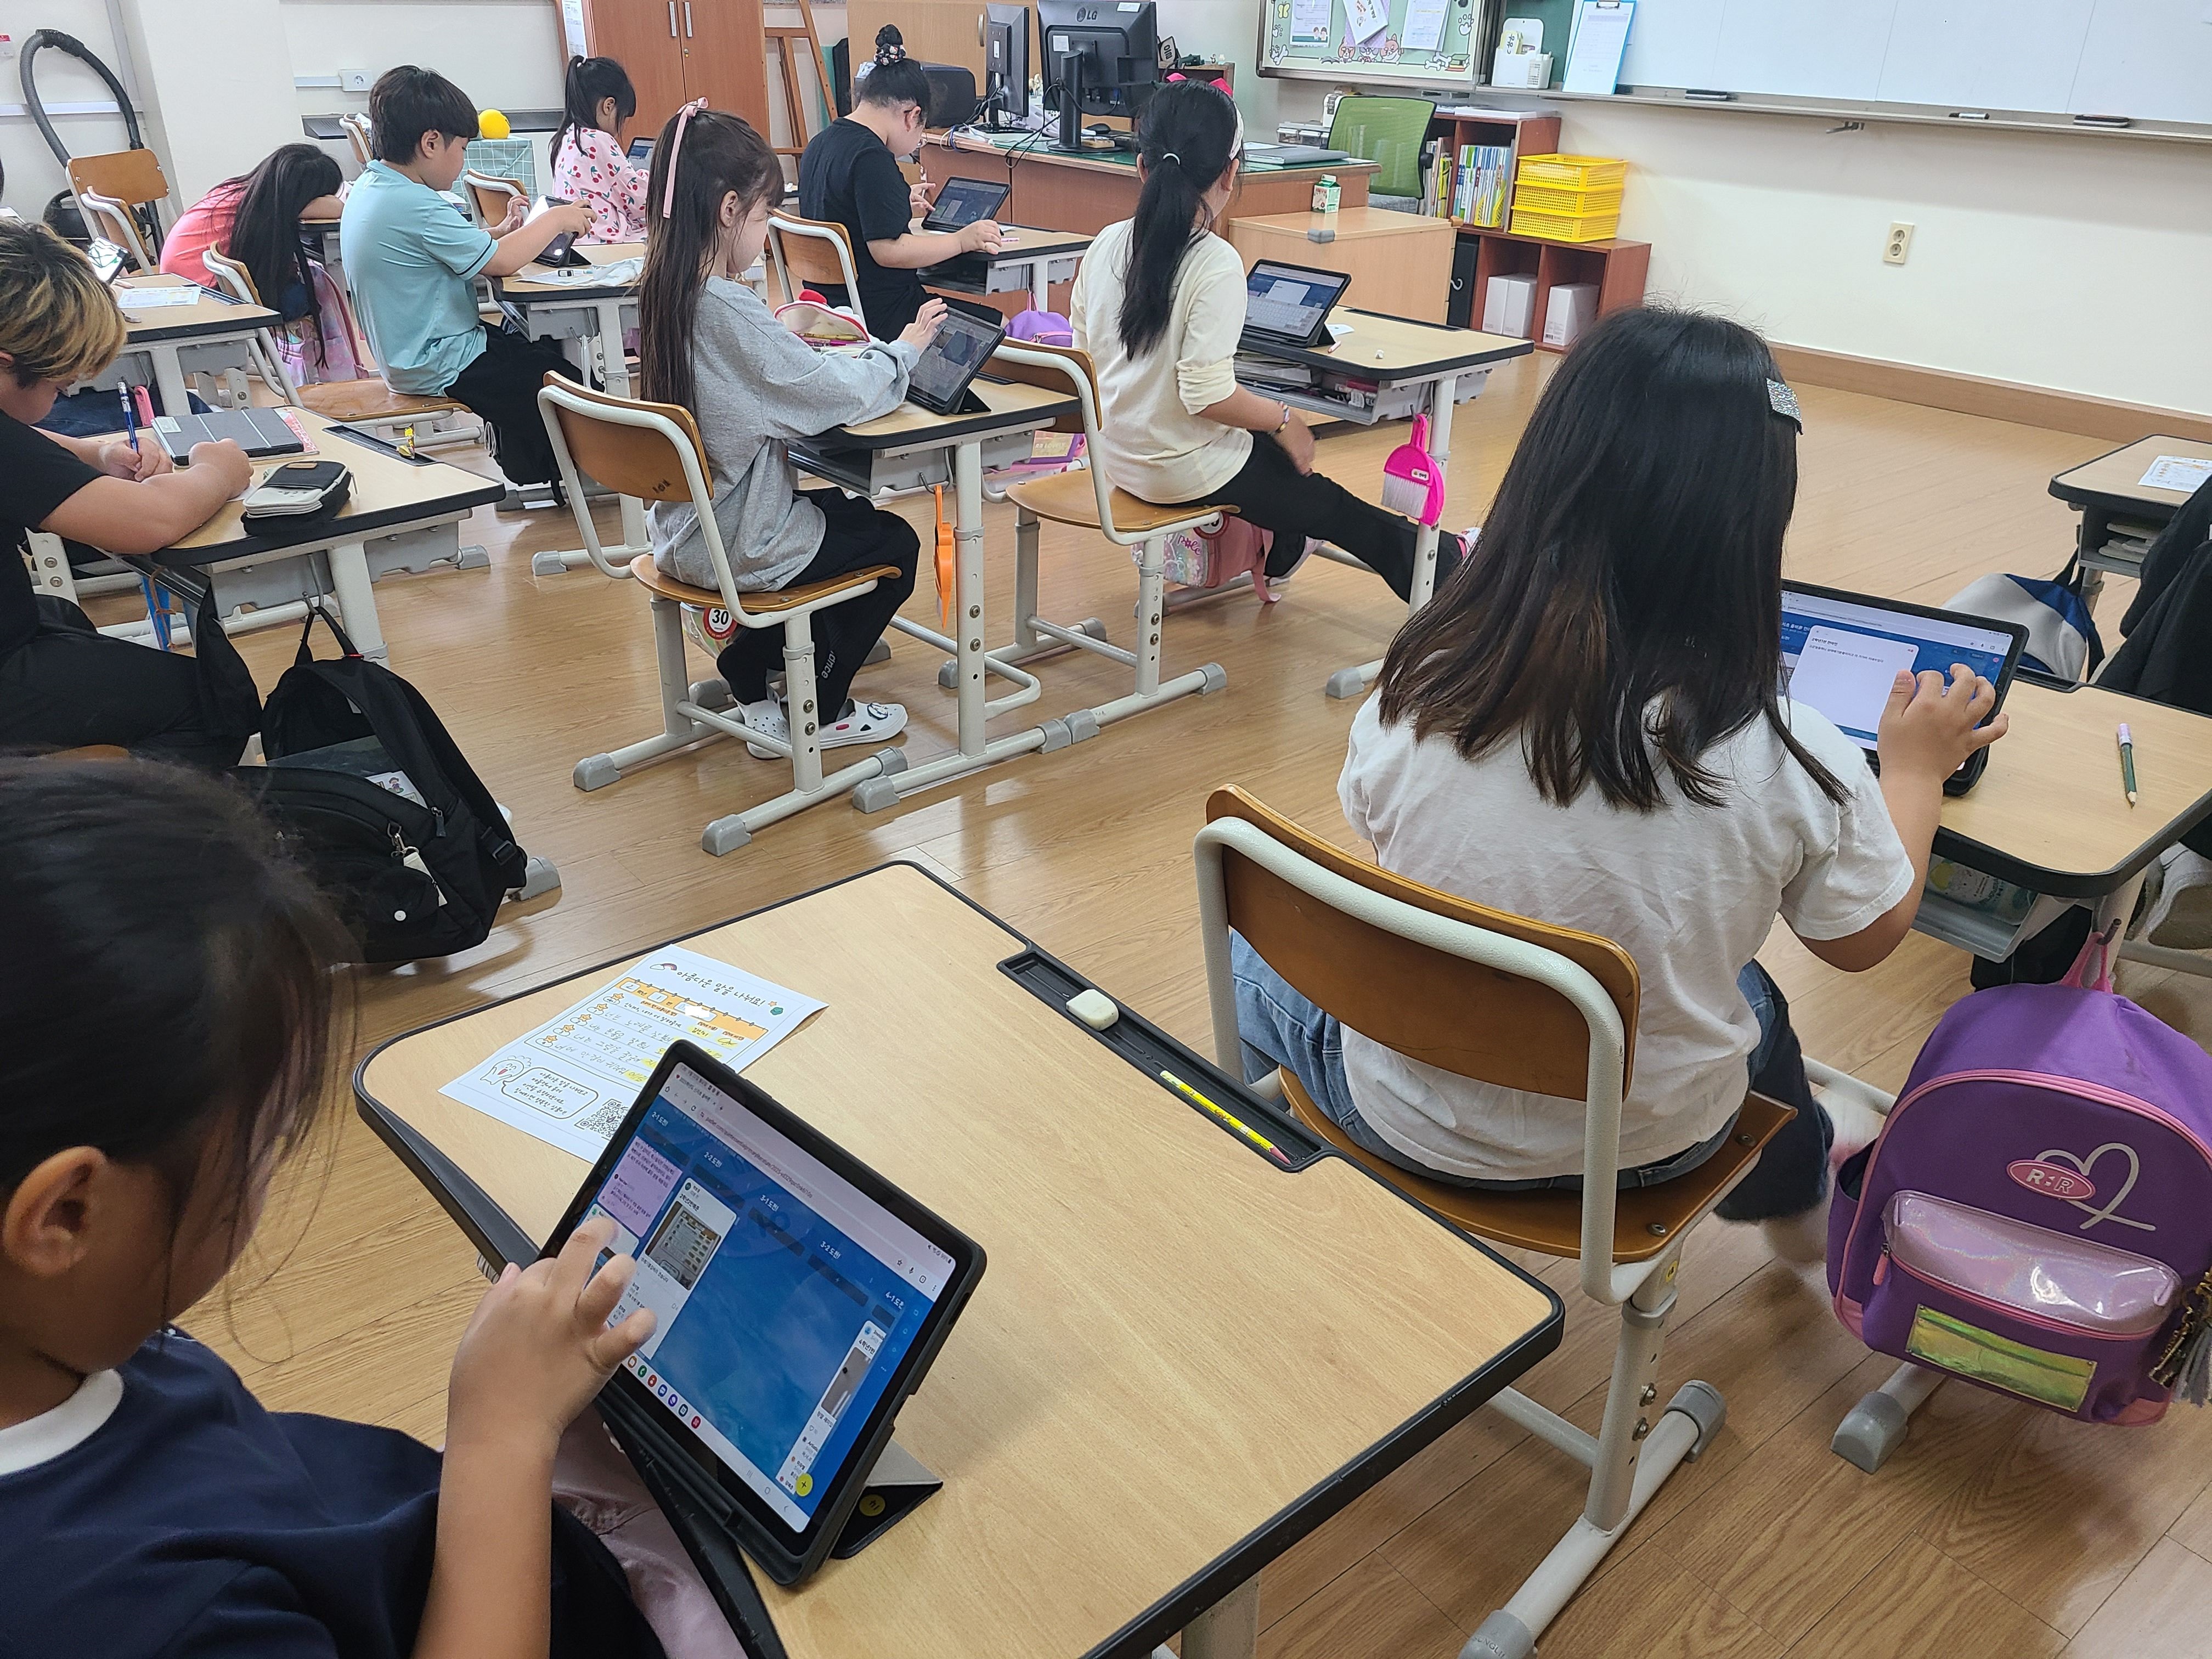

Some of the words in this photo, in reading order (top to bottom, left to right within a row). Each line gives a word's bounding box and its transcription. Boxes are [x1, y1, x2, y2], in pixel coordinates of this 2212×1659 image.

[1086, 10, 1098, 20] LG
[712, 608, 729, 625] 30
[676, 970, 713, 989] 아름다운
[713, 980, 735, 995] 말을
[734, 990, 766, 1008] 나눠요!
[535, 1071, 562, 1083] 아름다운
[555, 1080, 572, 1088] 말을
[650, 1110, 661, 1121] 2-1
[657, 1115, 669, 1127] 도전!
[703, 1150, 714, 1162] 2-2
[710, 1156, 723, 1169] 도전!
[759, 1193, 770, 1205] 3-1
[765, 1199, 780, 1214] 도전!
[819, 1240, 831, 1253] 3-2
[827, 1246, 842, 1261] 도전!
[883, 1290, 896, 1304] 4-1
